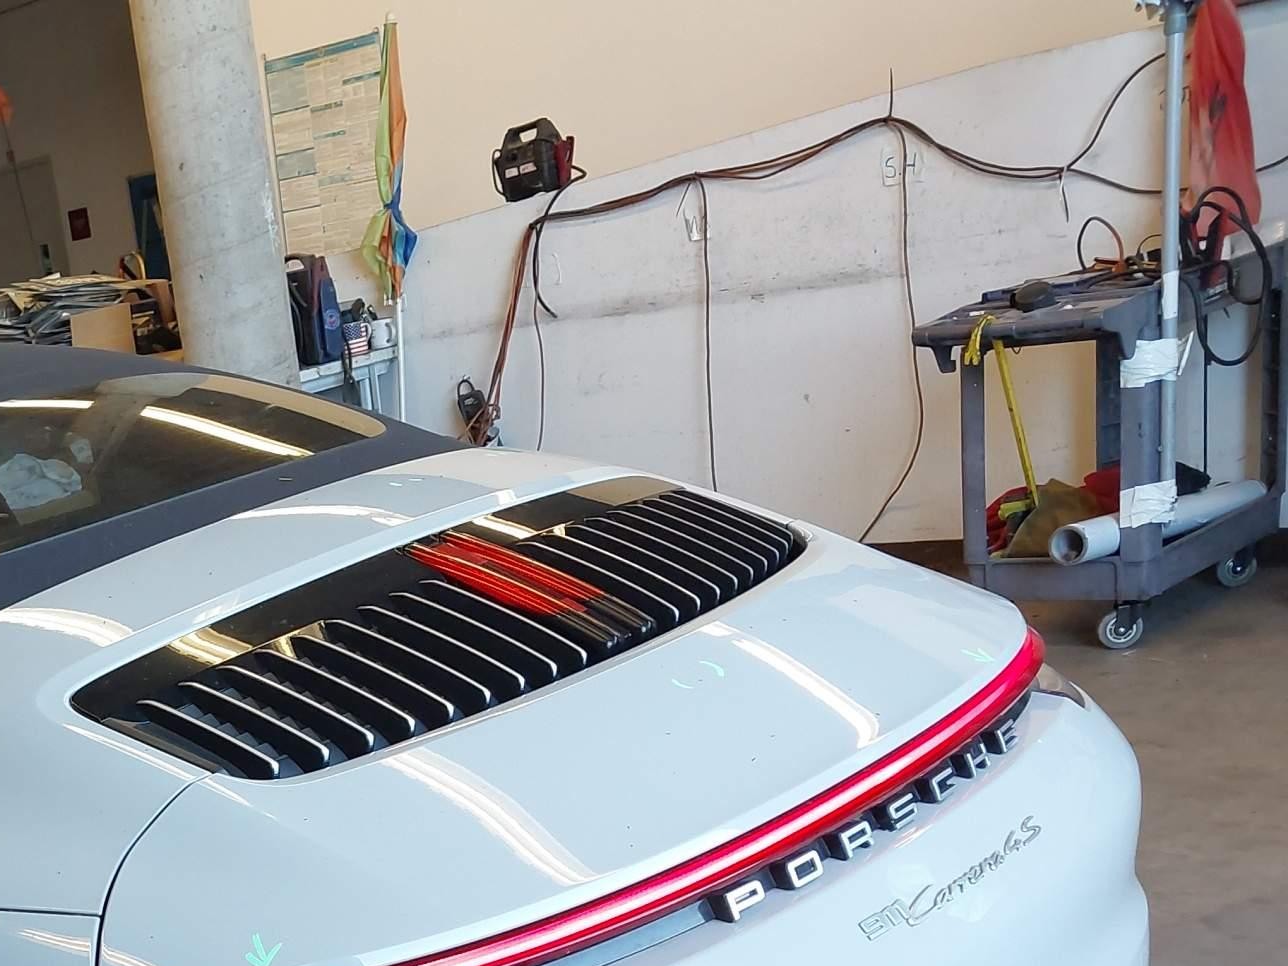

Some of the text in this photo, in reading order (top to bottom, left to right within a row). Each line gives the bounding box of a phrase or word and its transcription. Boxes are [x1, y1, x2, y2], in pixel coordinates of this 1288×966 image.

[724, 719, 1018, 923] PORSCHE
[858, 815, 1042, 941] 911 Carrera 4S
